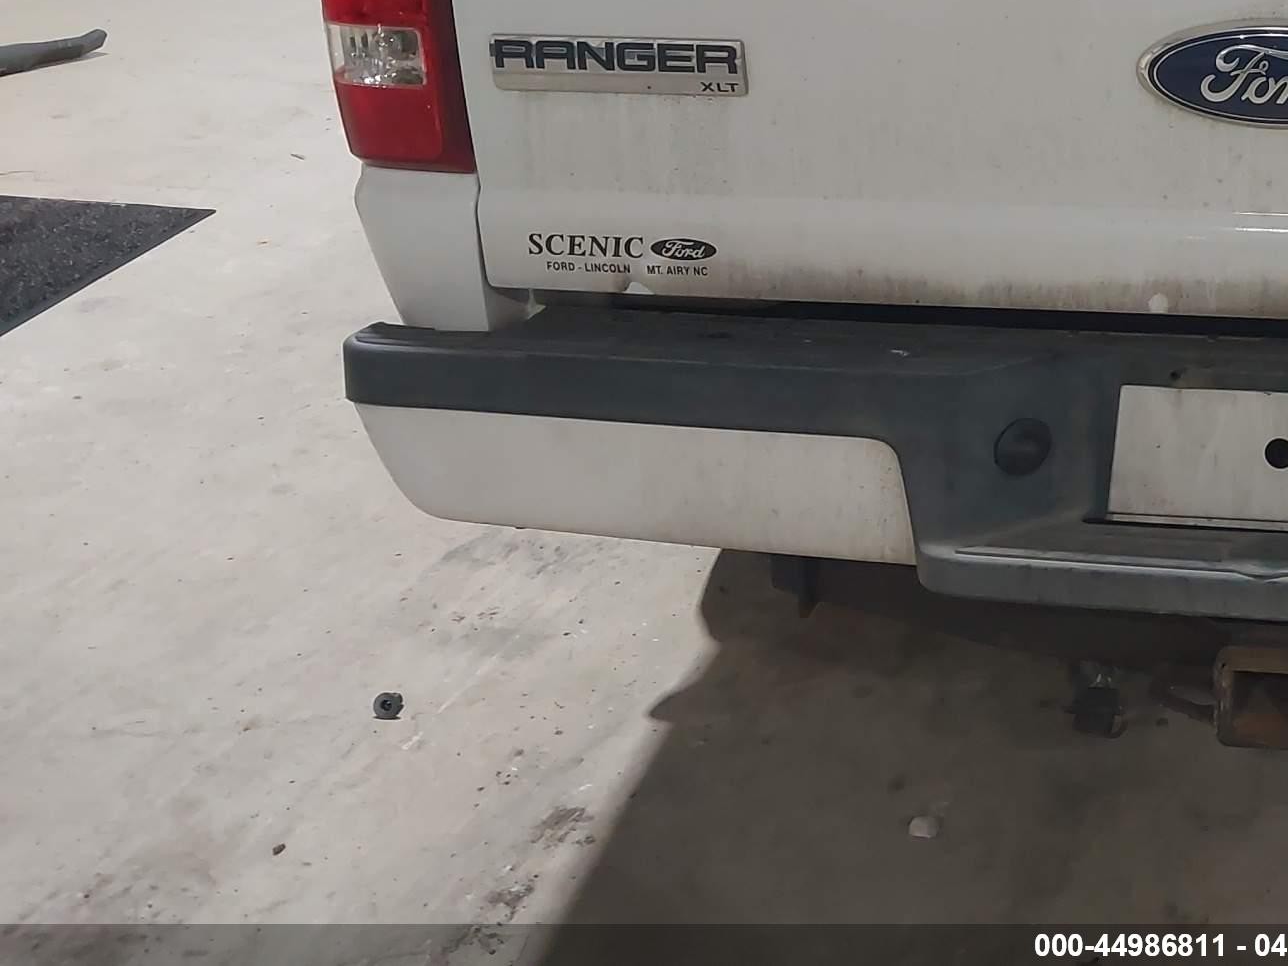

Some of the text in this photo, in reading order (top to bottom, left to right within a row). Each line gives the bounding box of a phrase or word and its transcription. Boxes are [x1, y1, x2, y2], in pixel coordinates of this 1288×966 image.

[494, 38, 739, 74] RANGER
[701, 82, 739, 93] XLT
[528, 233, 644, 259] SCENIC
[547, 261, 575, 271] FORD
[584, 263, 631, 274] LINCOLN
[647, 265, 663, 275] MT.
[666, 265, 690, 275] AIRY
[693, 266, 708, 276] NC
